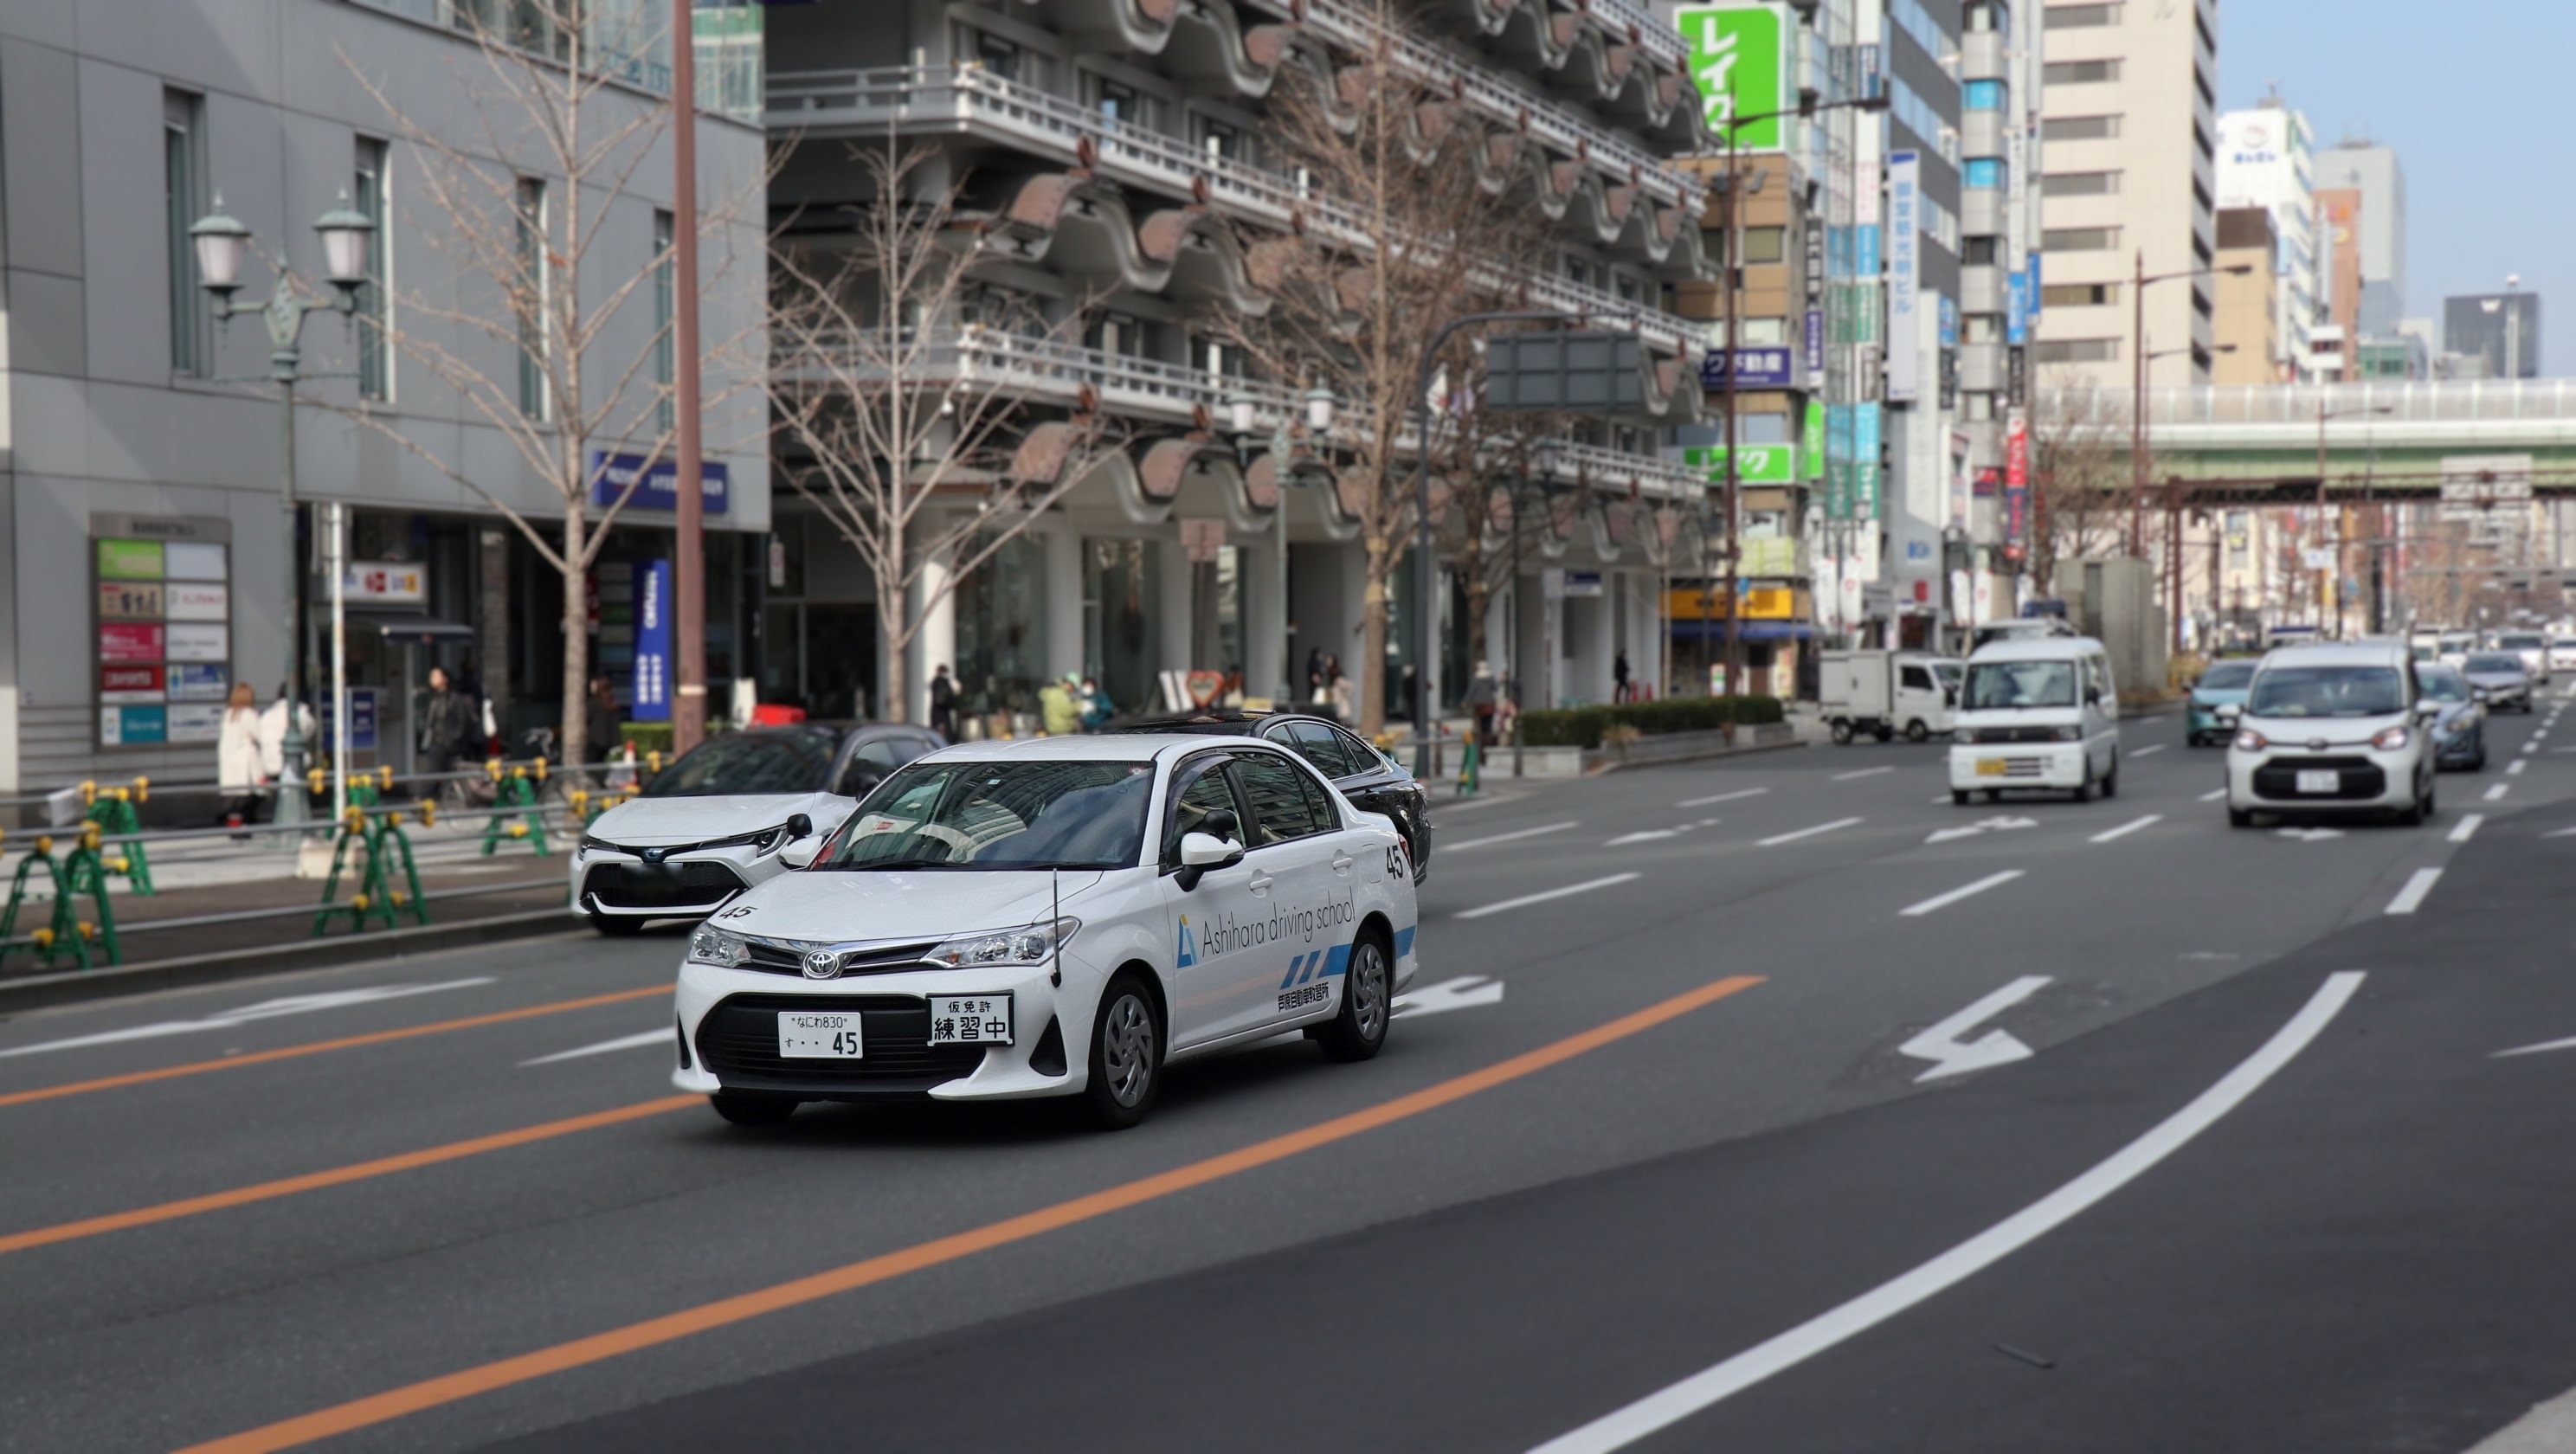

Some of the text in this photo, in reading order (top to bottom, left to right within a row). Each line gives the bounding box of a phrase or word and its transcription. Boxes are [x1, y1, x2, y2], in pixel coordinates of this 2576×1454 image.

[1699, 16, 1738, 132] レイク
[1387, 845, 1403, 879] 45
[719, 906, 758, 918] 45
[1202, 885, 1356, 958] Ashihara driving school
[948, 1000, 991, 1013] 仮免許
[1278, 981, 1330, 1013] 芦原自動車教習所
[934, 1016, 1006, 1040] 練習中
